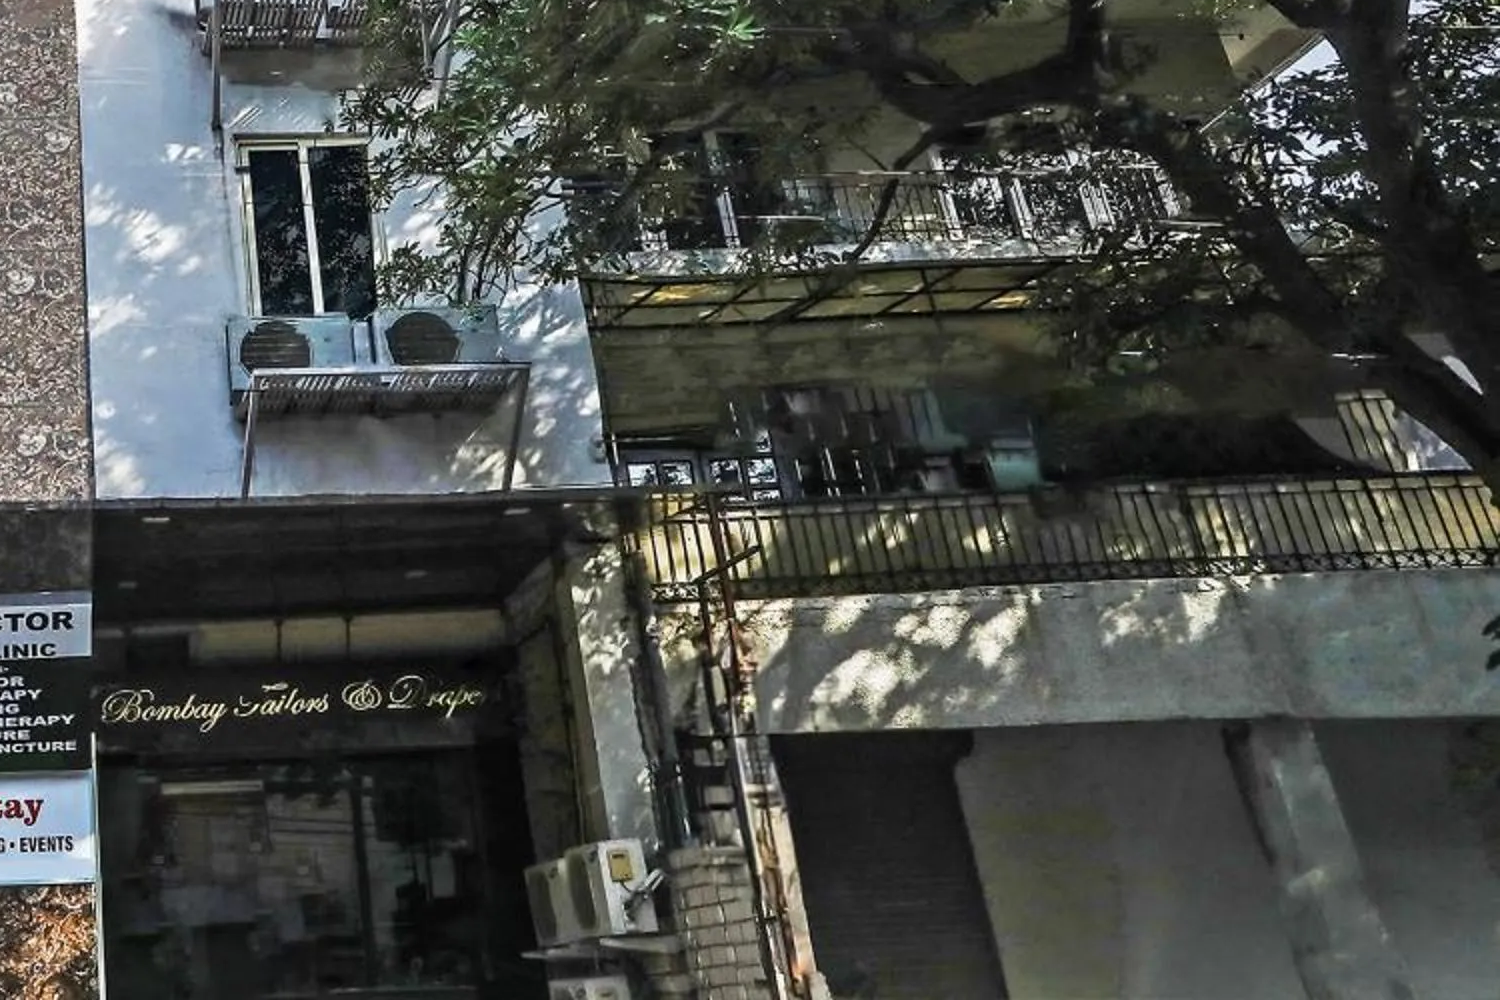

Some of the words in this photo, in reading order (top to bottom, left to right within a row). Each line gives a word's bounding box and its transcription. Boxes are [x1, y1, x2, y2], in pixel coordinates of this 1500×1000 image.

[101, 689, 229, 733] Bombay
[233, 682, 330, 717] Tailors
[342, 678, 383, 711] &
[19, 835, 74, 853] EVENTS
